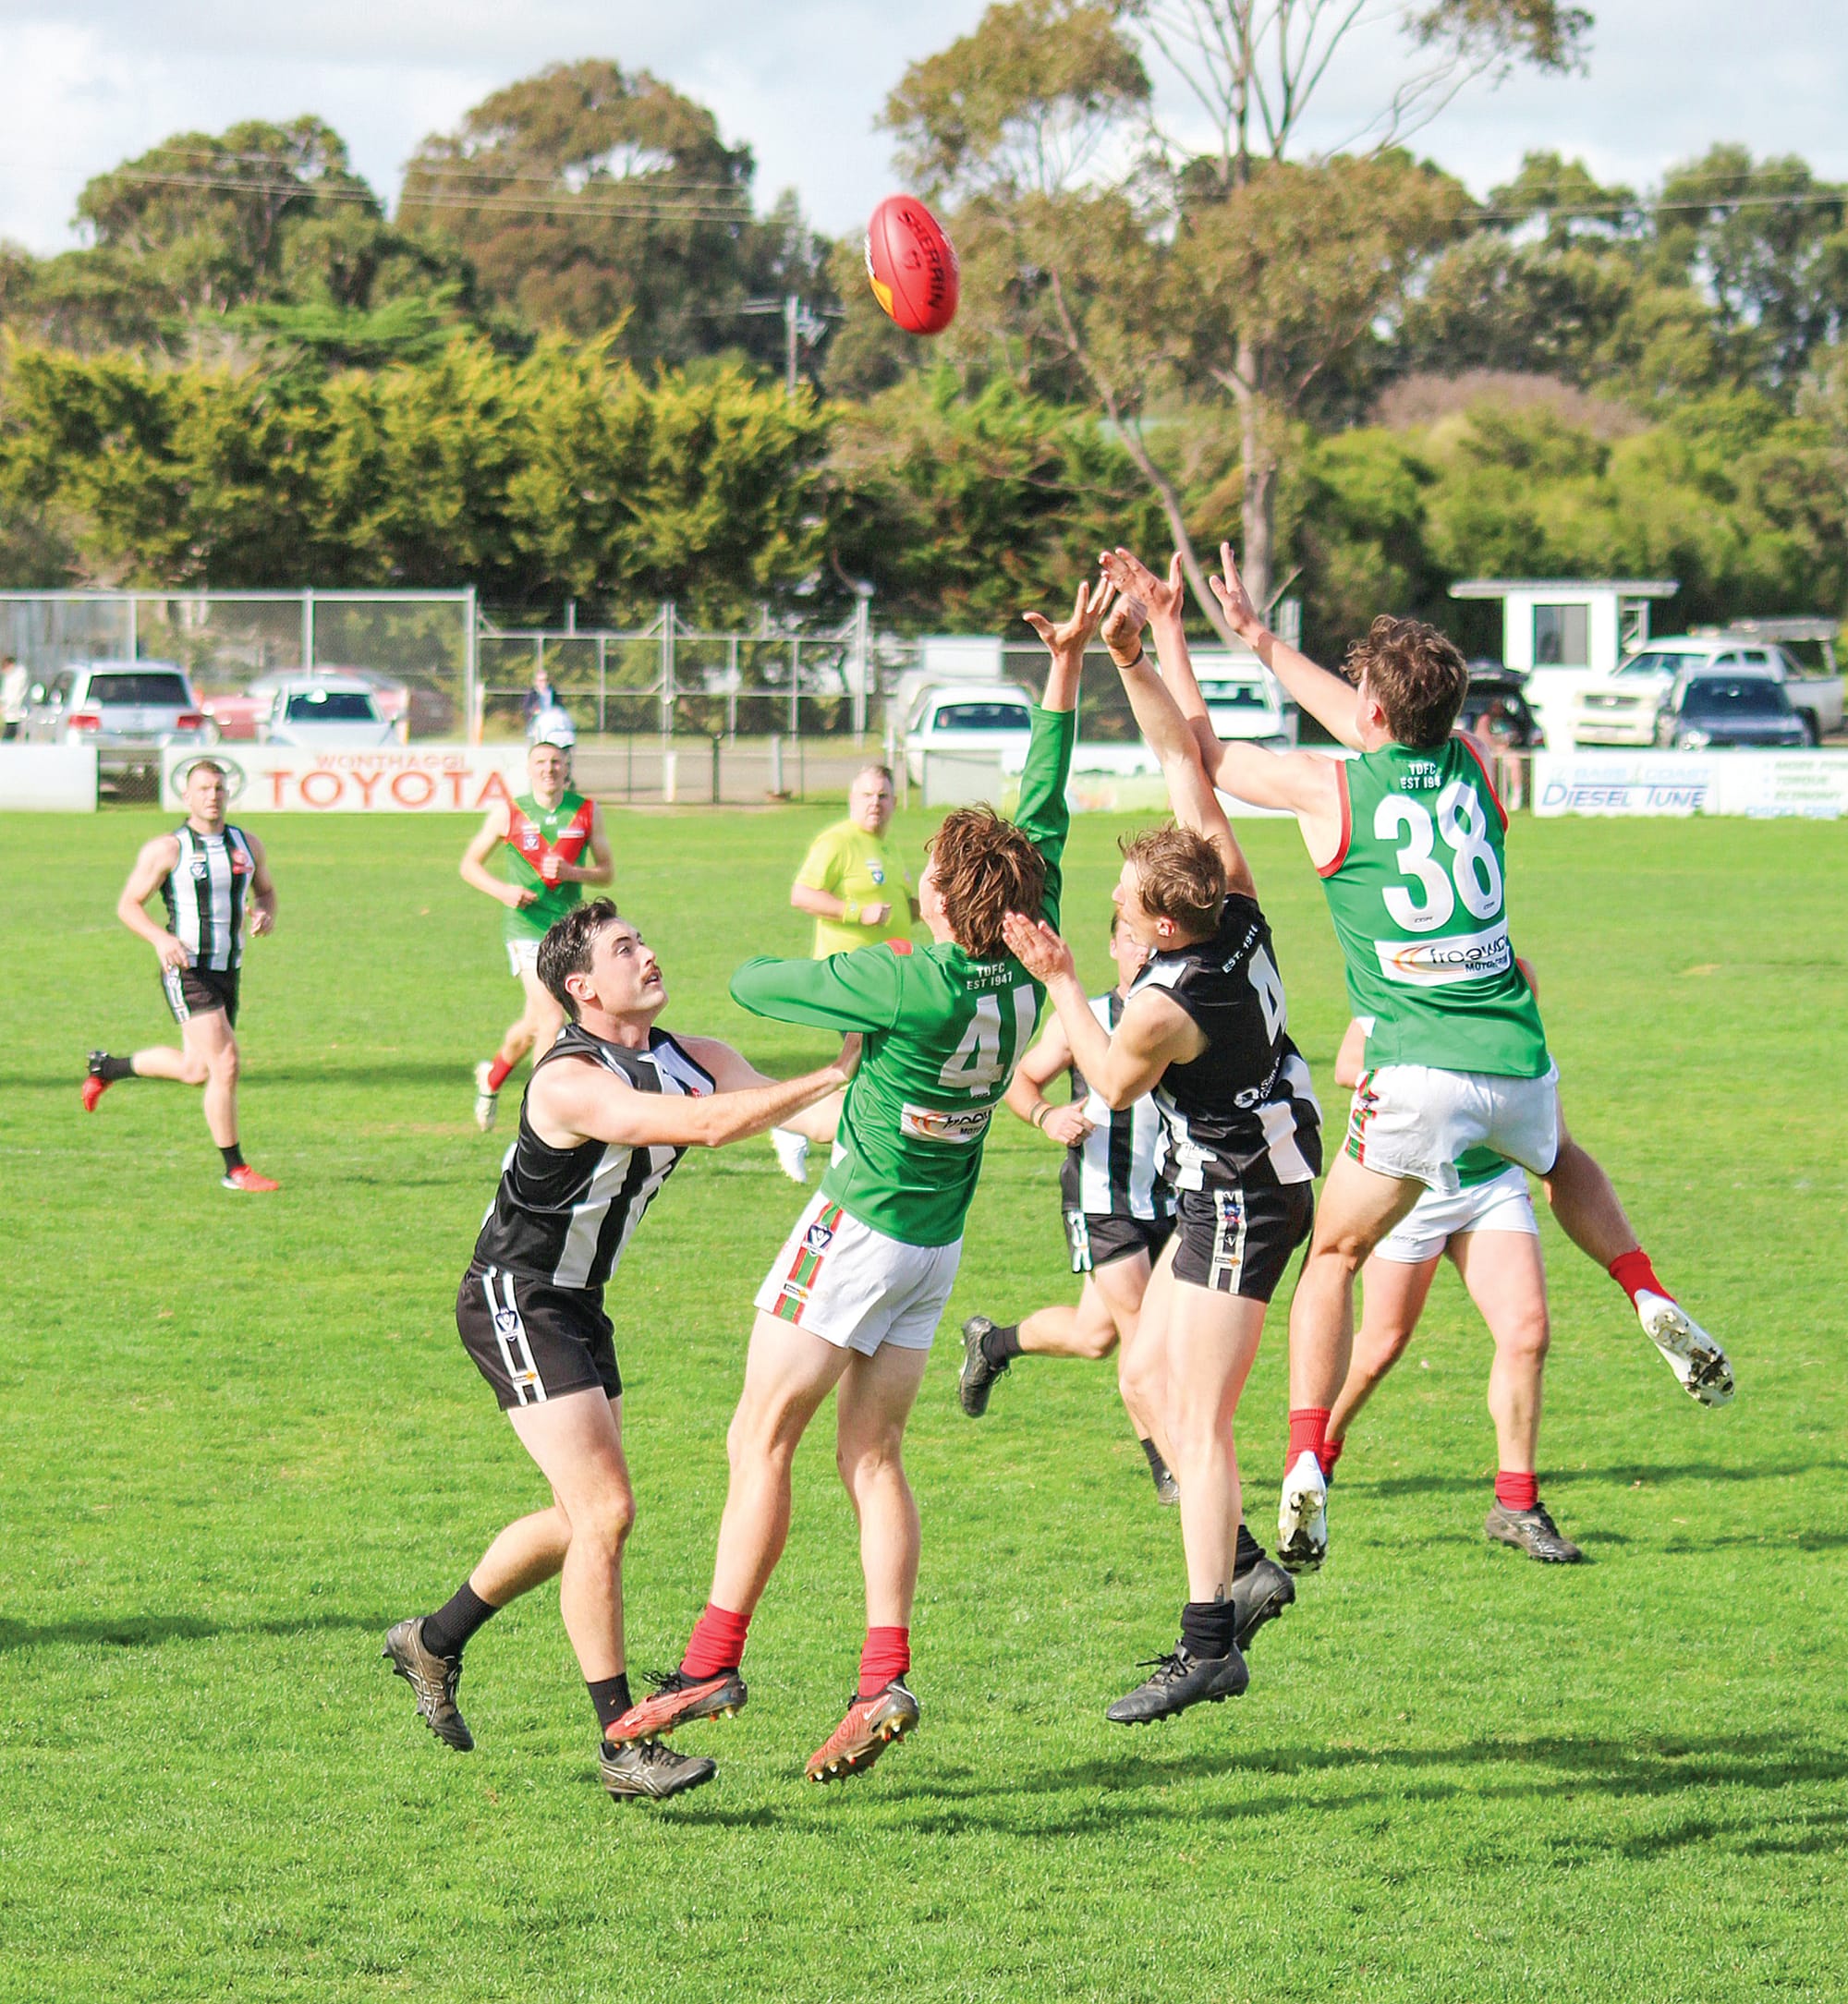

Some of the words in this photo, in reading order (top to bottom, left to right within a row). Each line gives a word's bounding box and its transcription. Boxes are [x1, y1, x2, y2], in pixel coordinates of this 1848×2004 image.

[897, 209, 945, 310] SHERRIN
[315, 753, 466, 769] WONTHAGGI
[1408, 762, 1436, 775] TDFC
[264, 771, 511, 808] TOYOTA
[1400, 777, 1419, 789] EST
[1541, 783, 1631, 808] DIESEL
[1644, 784, 1707, 808] TUNE
[1374, 782, 1502, 932] 38
[977, 962, 1004, 978] TDFC
[1222, 950, 1244, 974] EST.
[967, 979, 987, 990] EST
[991, 971, 1013, 987] 1947
